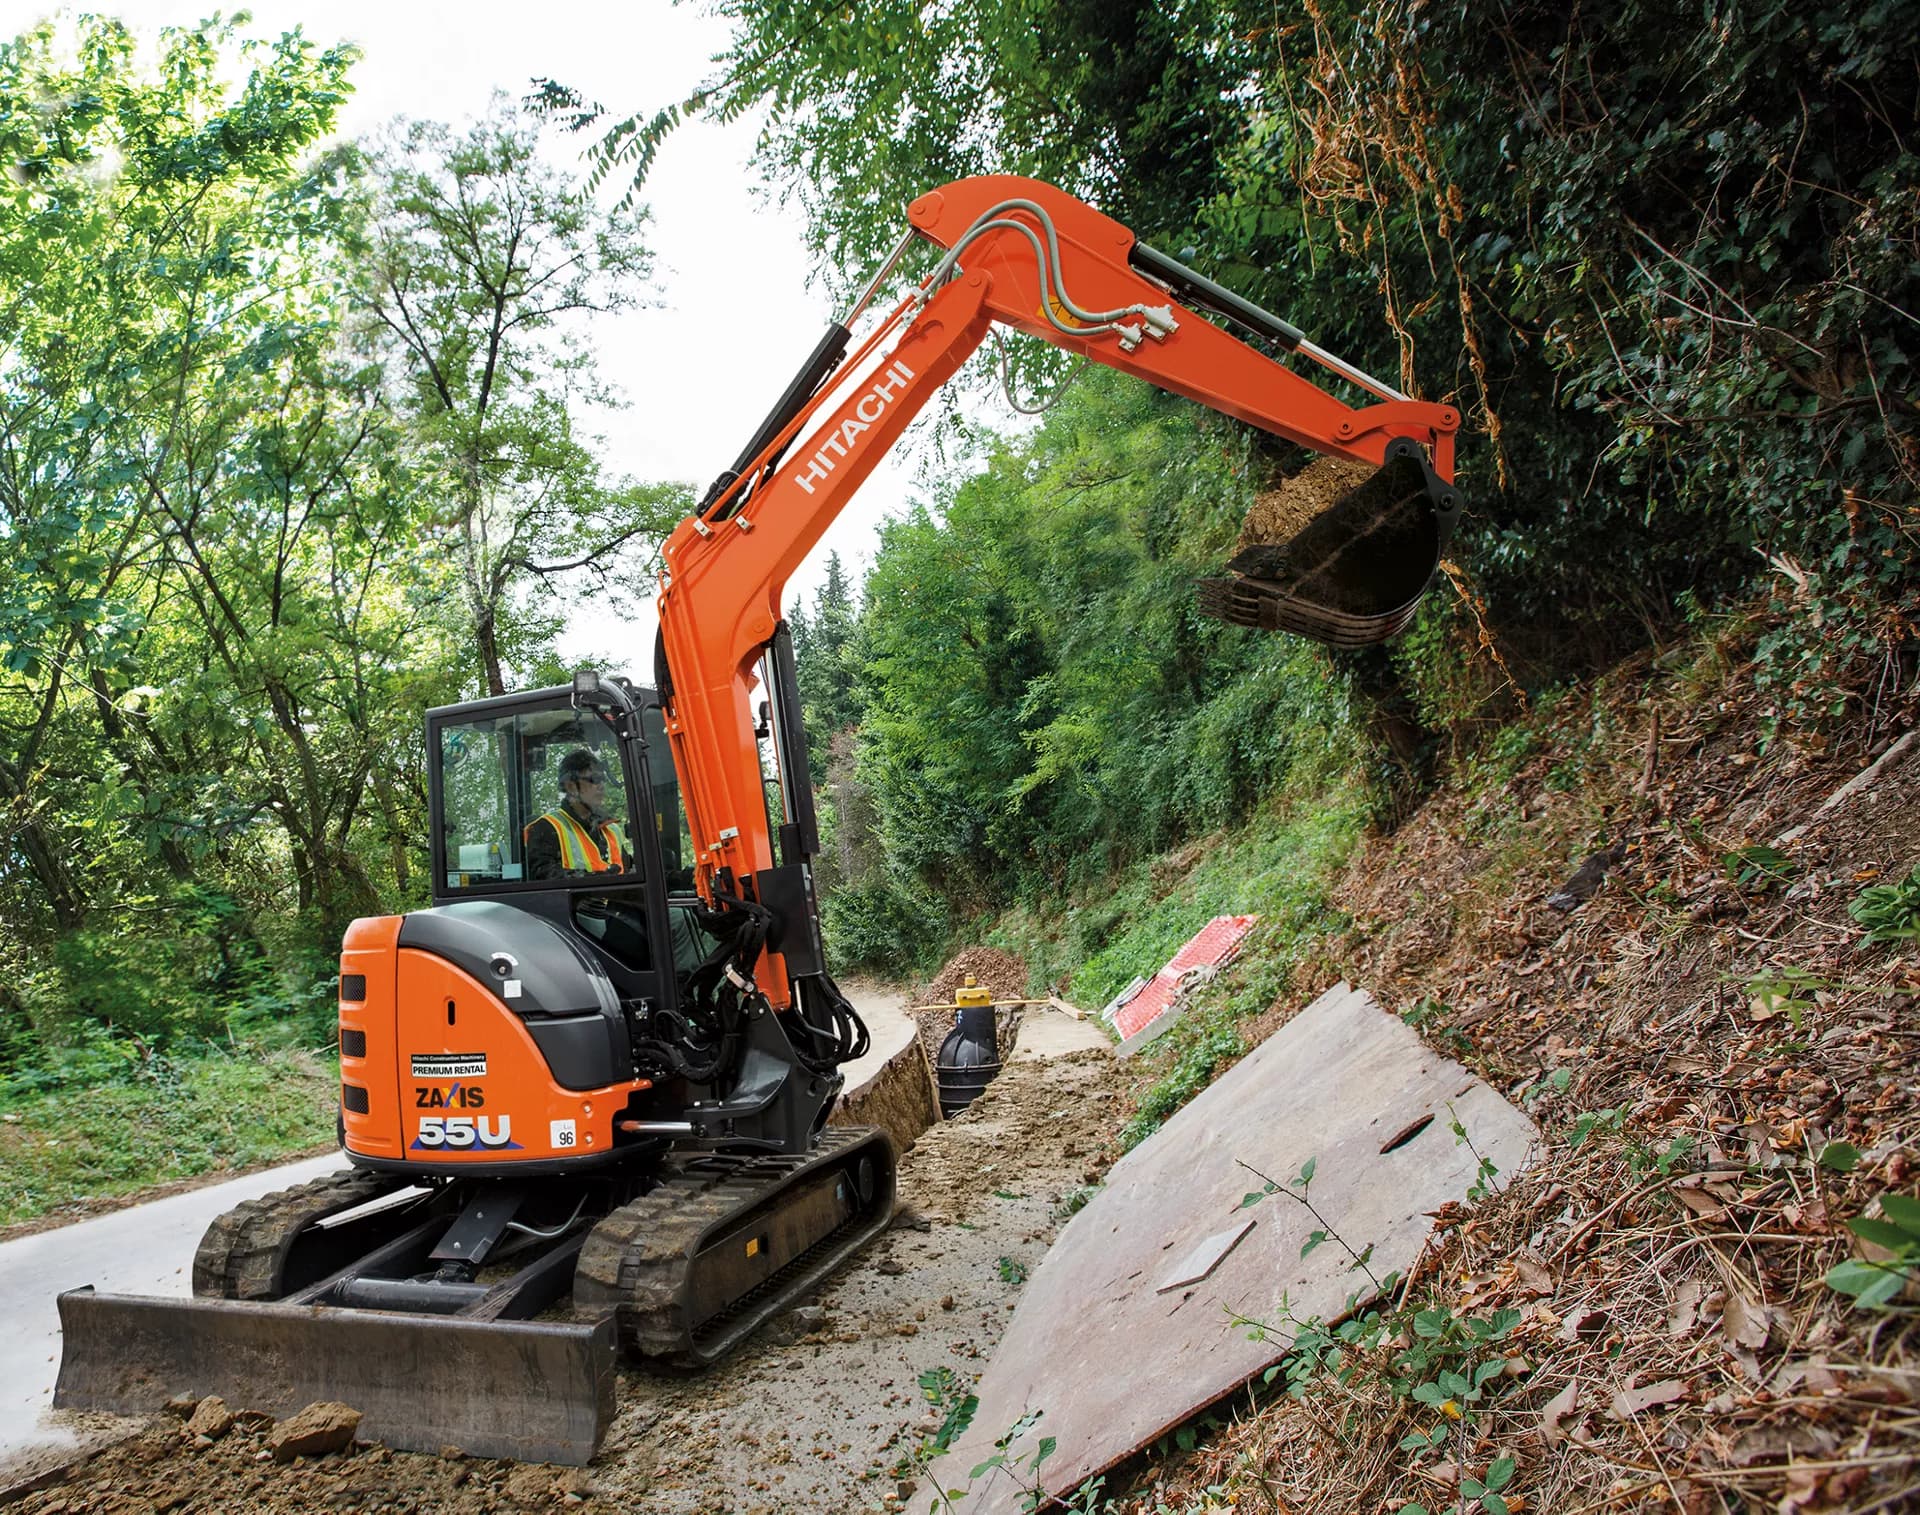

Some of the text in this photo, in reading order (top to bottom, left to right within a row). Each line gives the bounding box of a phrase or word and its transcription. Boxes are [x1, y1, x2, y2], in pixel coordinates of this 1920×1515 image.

[794, 360, 915, 495] HITACHI
[413, 1064, 485, 1075] PREMIUM RENTAL
[416, 1082, 485, 1108] ZAXIS
[418, 1114, 512, 1149] 55U
[559, 1131, 574, 1145] 96
